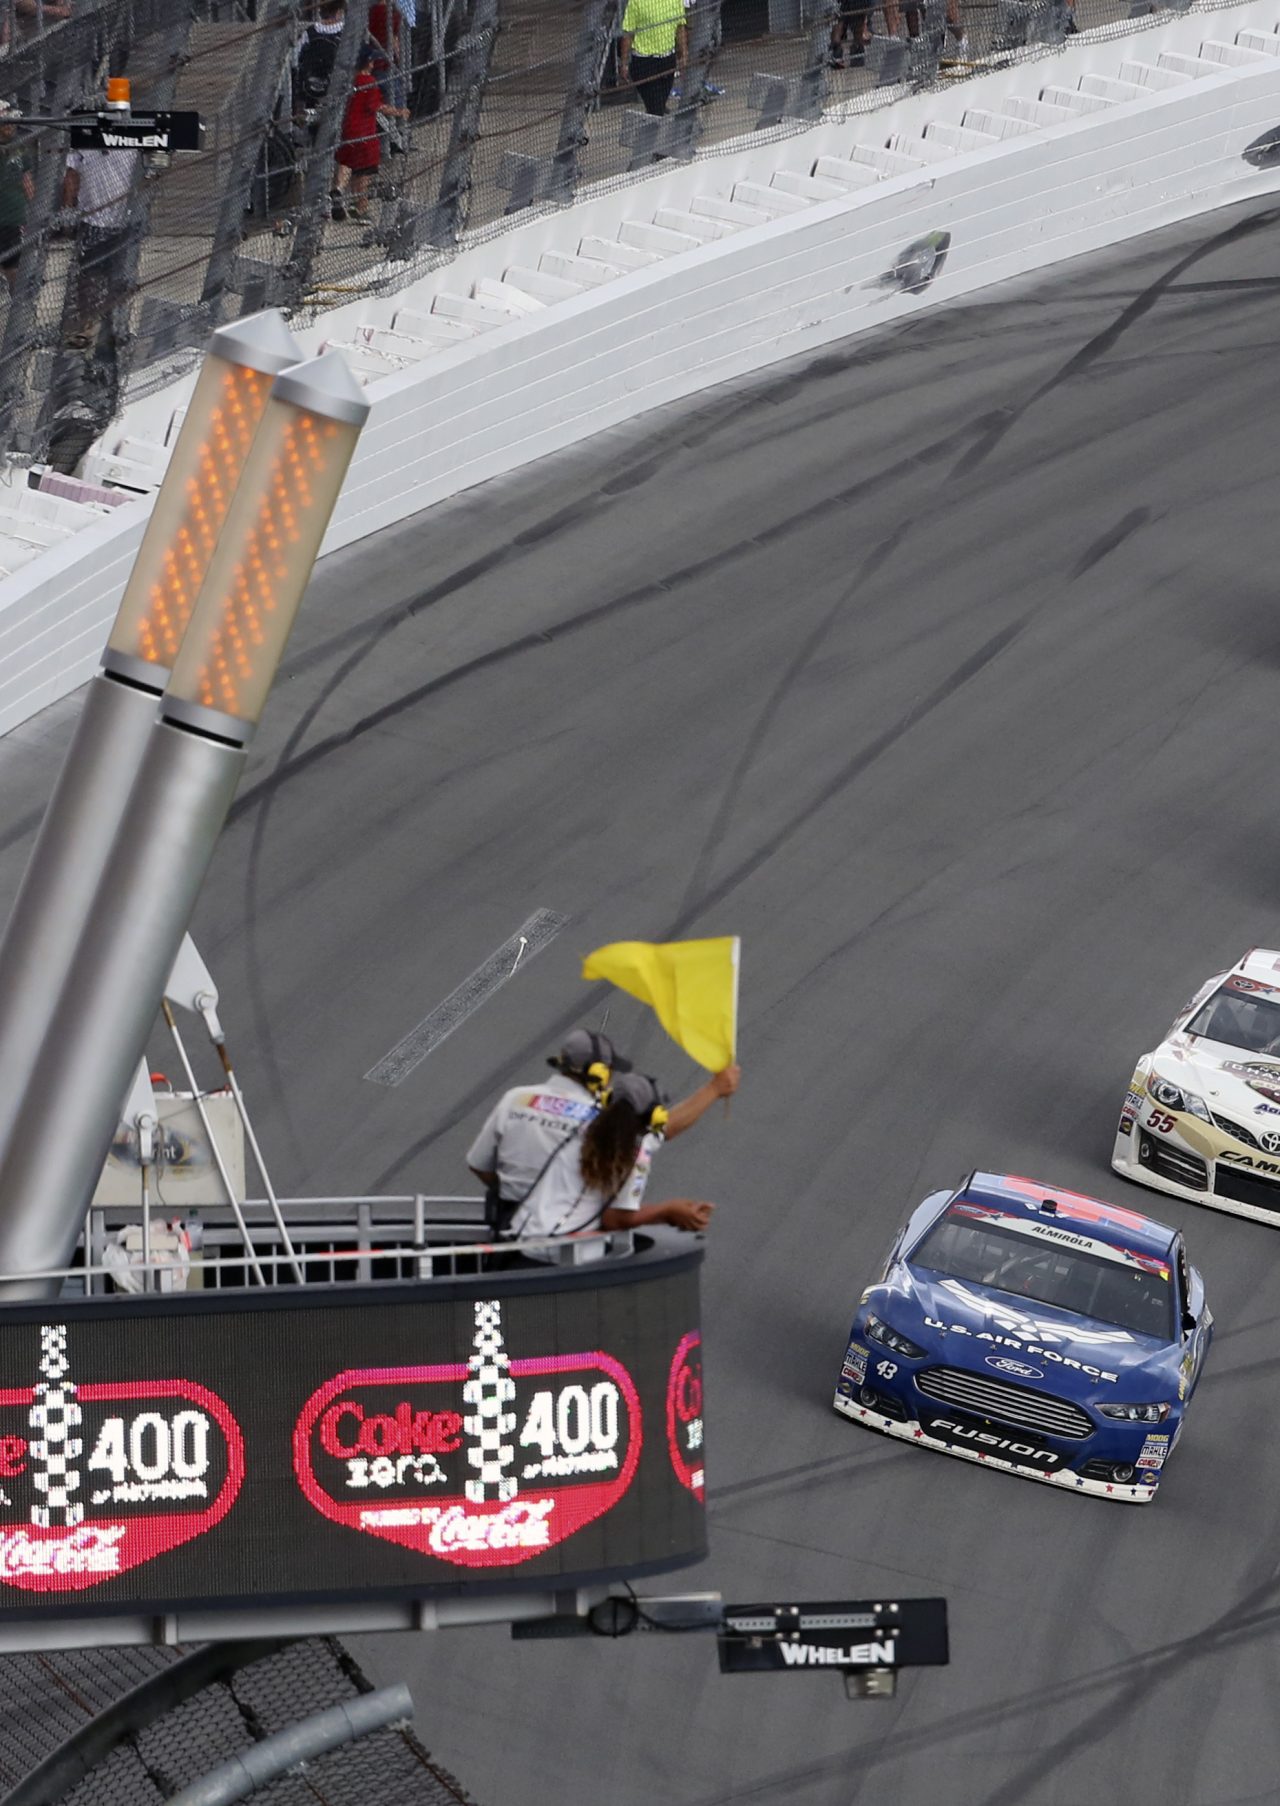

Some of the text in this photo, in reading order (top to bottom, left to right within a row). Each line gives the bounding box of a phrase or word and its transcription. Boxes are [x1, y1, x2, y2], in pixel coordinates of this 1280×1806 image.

[101, 132, 169, 148] WHELEN
[1146, 1109, 1178, 1133] 55
[1031, 1225, 1094, 1249] ALMIROLA
[923, 1316, 1119, 1384] U.S. AIR FORCE
[876, 1360, 899, 1380] 43
[994, 1358, 1033, 1377] Ford
[519, 1377, 620, 1456] 400
[319, 1401, 463, 1459] Coke
[929, 1418, 1060, 1464] FUSION
[88, 1410, 210, 1482] 400
[779, 1639, 895, 1665] WHELEN
